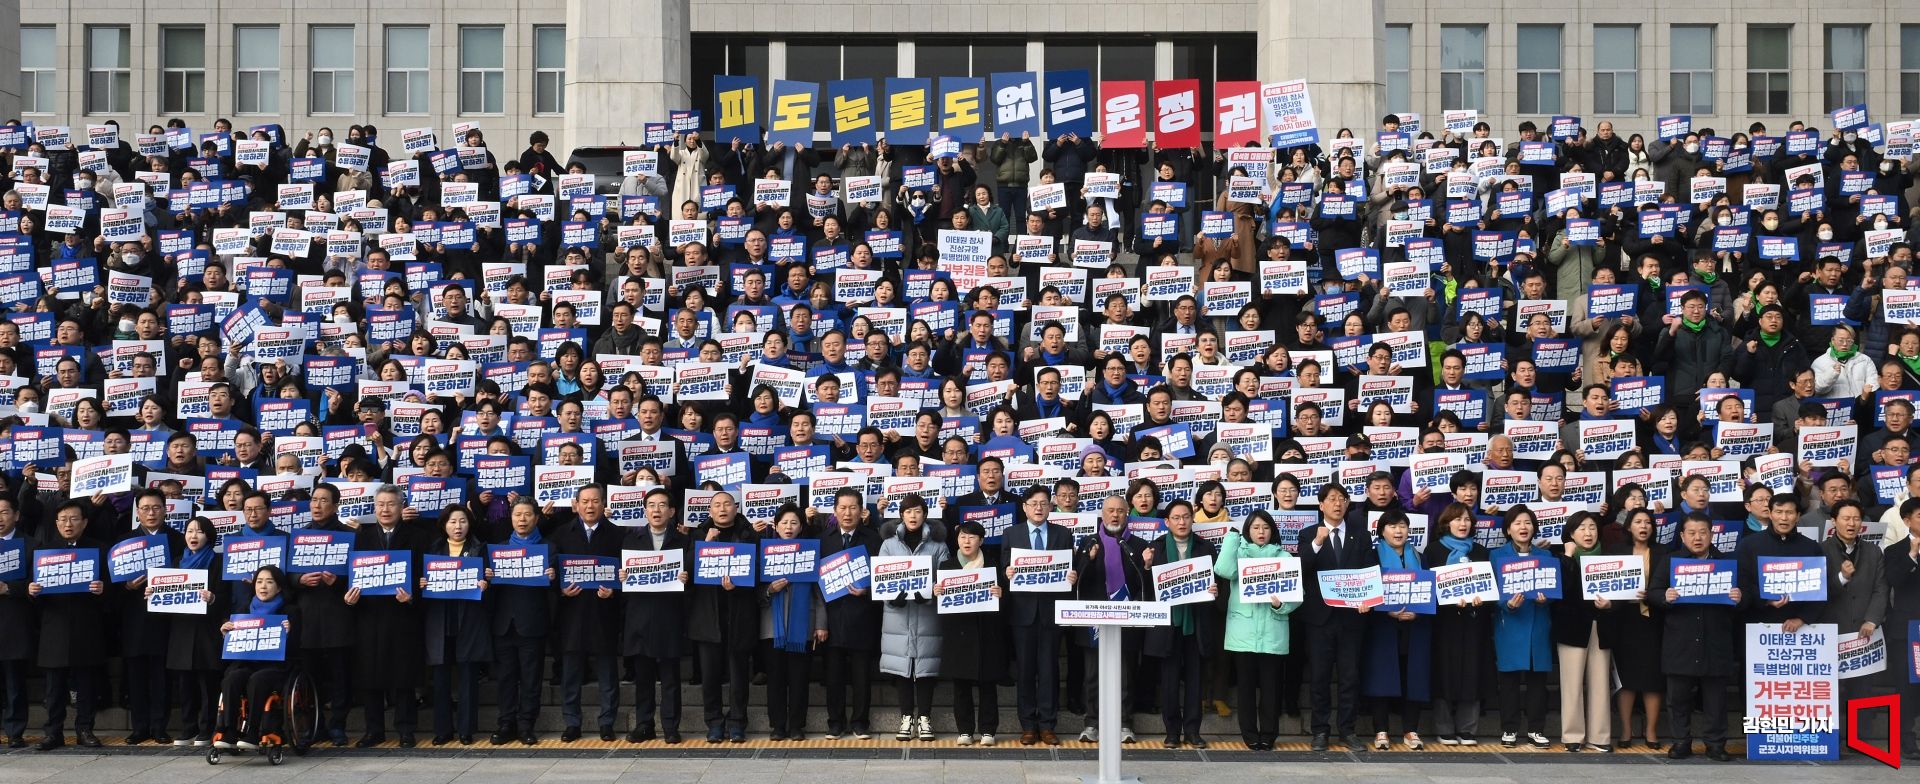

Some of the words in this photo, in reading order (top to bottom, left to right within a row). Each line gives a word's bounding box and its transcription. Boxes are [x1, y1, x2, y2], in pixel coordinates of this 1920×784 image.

[997, 82, 1035, 125] 없
[1050, 87, 1085, 125] 는
[1267, 96, 1288, 104] 이태원
[719, 88, 754, 128] 피
[773, 93, 811, 131] 도
[834, 96, 870, 133] 눈
[890, 89, 925, 130] 물
[944, 88, 979, 128] 도
[1106, 94, 1141, 134] 윤
[1158, 90, 1194, 134] 정
[1219, 92, 1256, 135] 권
[946, 236, 968, 244] 이태원
[969, 236, 984, 244] 참사
[942, 265, 985, 276] 거부권을
[1264, 278, 1303, 290] 수용하라!
[1388, 280, 1427, 291] 수용하라!
[258, 347, 300, 358] 수용하라!
[428, 379, 470, 391] 수용하라!
[680, 382, 724, 396] 수용하라!
[870, 416, 916, 429] 수용하라!
[1722, 442, 1770, 455] 수용하라!
[1803, 446, 1853, 460] 수용하라!
[74, 474, 126, 490] 수용하라!
[493, 558, 521, 569] 거부권
[523, 555, 544, 566] 남발
[629, 557, 660, 565] 윤석열정권
[764, 553, 794, 565] 거부권
[795, 550, 816, 562] 남발
[1018, 557, 1049, 565] 윤석열정권
[38, 562, 70, 577] 거부권
[71, 560, 94, 571] 남발
[353, 565, 384, 577] 거부권
[385, 561, 406, 572] 남발
[493, 568, 521, 579] 국민이
[523, 567, 543, 577] 심판
[626, 562, 680, 573] 이태원참사특별법
[764, 565, 793, 576] 국민이
[795, 563, 815, 573] 심판
[821, 567, 850, 587] 거부권
[849, 555, 866, 572] 남발
[878, 562, 908, 572] 윤석열정권
[1014, 562, 1069, 573] 이태원참사특별법
[1161, 566, 1191, 581] 윤석열정권
[1246, 564, 1277, 573] 윤석열정권
[1589, 564, 1619, 572] 윤석열정권
[37, 574, 70, 588] 국민이
[71, 571, 94, 583] 심판
[154, 576, 184, 584] 윤석열정권
[353, 576, 383, 589] 국민이
[384, 573, 406, 585] 심판
[626, 570, 679, 586] 수용하라!
[826, 577, 852, 595] 국민이
[853, 567, 870, 583] 심판
[875, 568, 929, 582] 이태원참사특별법
[945, 575, 975, 586] 윤석열정권
[1014, 571, 1067, 586] 수용하라!
[1158, 569, 1211, 590] 이태원참사특별법
[1243, 571, 1299, 584] 이태원참사특별법
[1438, 573, 1491, 589] 이태원참사특별법
[1440, 569, 1469, 580] 윤석열정권
[1586, 569, 1641, 582] 이태원참사특별법
[1763, 571, 1796, 584] 거부권
[1798, 569, 1821, 581] 남발
[151, 583, 205, 593] 이태원참사특별법
[875, 577, 928, 594] 수용하라!
[941, 581, 995, 596] 이태원참사특별법
[1160, 577, 1211, 602] 수용하라!
[1243, 580, 1296, 597] 수용하라!
[1441, 583, 1492, 599] 수용하라!
[1586, 579, 1639, 595] 수용하라!
[1764, 582, 1796, 594] 국민이
[1798, 581, 1821, 591] 심판
[151, 591, 201, 606] 수용하라!
[941, 590, 993, 608] 수용하라!
[229, 629, 258, 641] 거부권
[259, 627, 282, 637] 남발
[1759, 634, 1796, 645] 이태원
[1801, 634, 1825, 645] 참사
[226, 640, 256, 653] 국민이
[257, 638, 280, 650] 심판
[1768, 649, 1816, 660] 진상규명
[1839, 649, 1883, 673] 수용하라!
[1754, 664, 1802, 675] 특별법에
[1807, 664, 1832, 675] 대한
[1754, 681, 1831, 699] 거부권을
[1767, 734, 1819, 743] 더불어민주당
[1759, 745, 1827, 754] 군포시지역위원회
